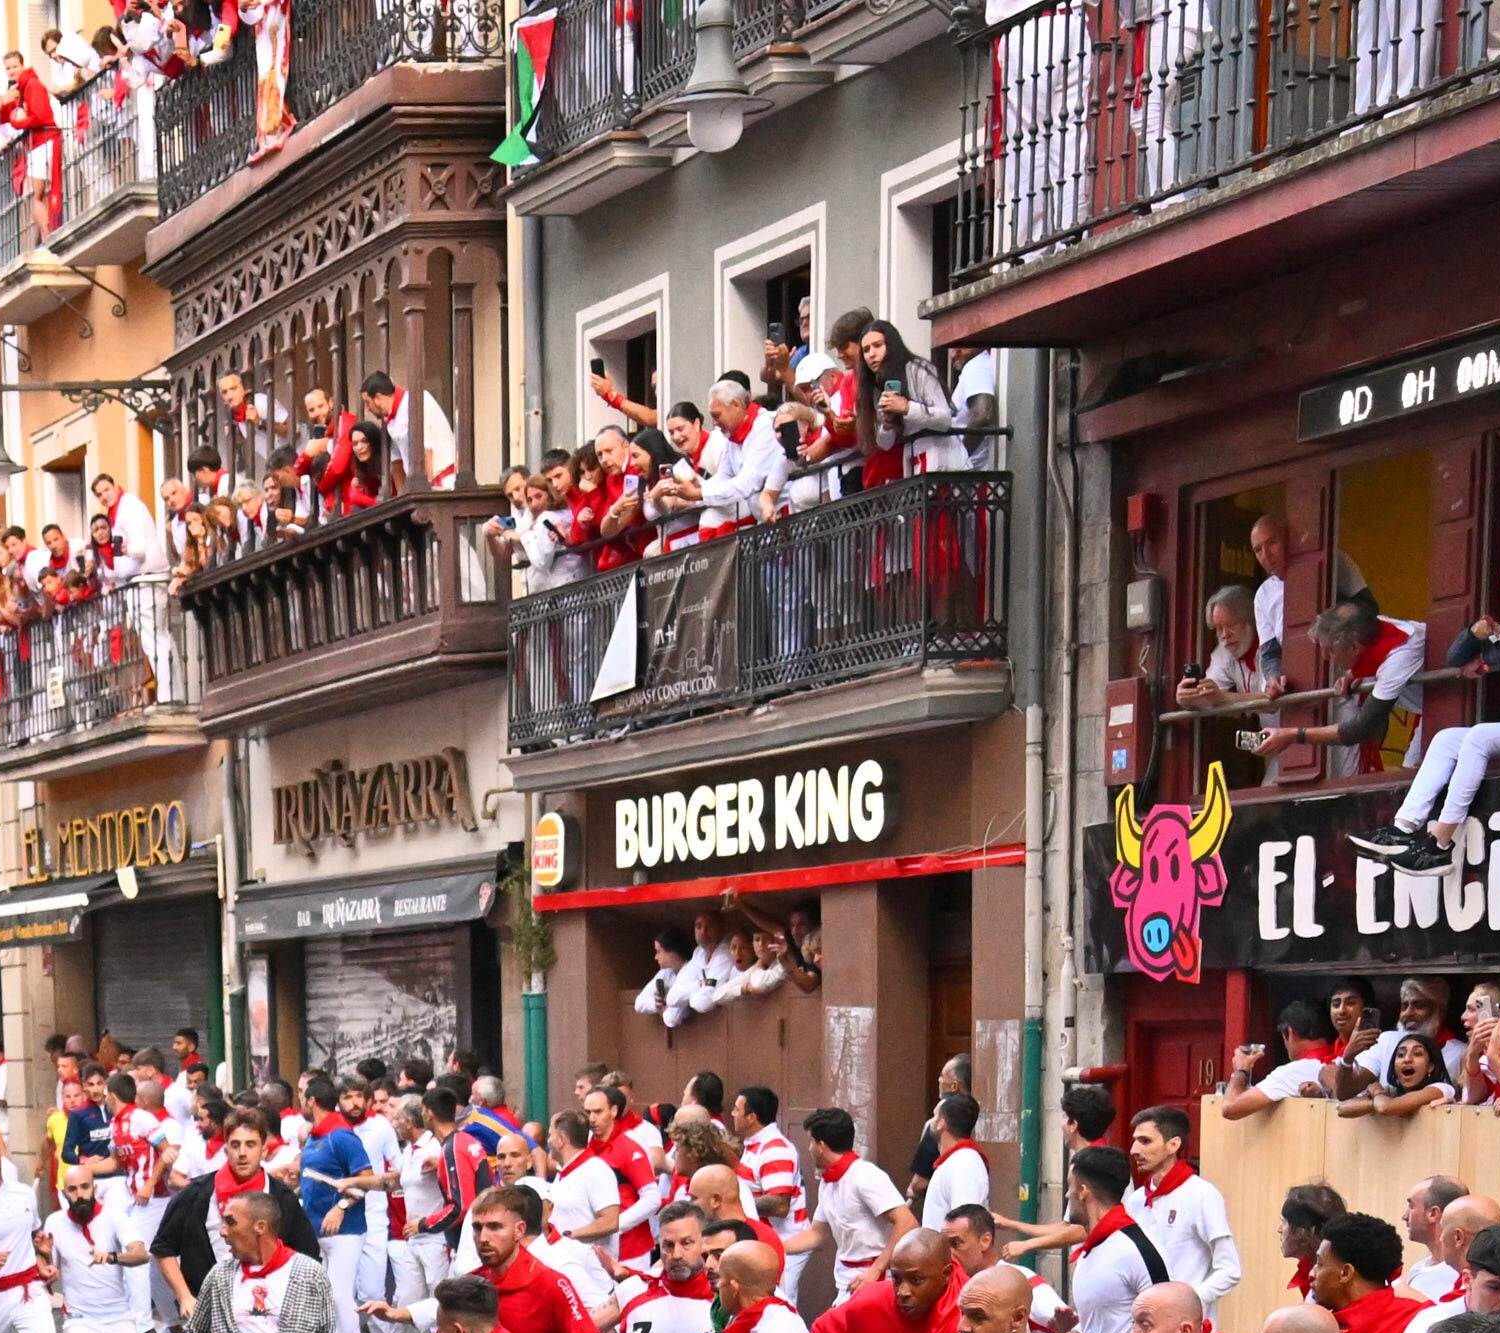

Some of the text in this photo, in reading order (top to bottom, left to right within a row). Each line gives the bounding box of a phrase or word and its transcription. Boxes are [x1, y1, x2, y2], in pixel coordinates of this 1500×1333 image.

[615, 759, 885, 869] BURGER KING
[56, 800, 188, 879] MENTIDERO
[534, 838, 559, 851] BURGER
[534, 853, 559, 869] KING
[1258, 834, 1324, 941] EL
[297, 910, 311, 927] BAR
[394, 894, 448, 917] RESTAURANTE
[1198, 1058, 1214, 1087] 19
